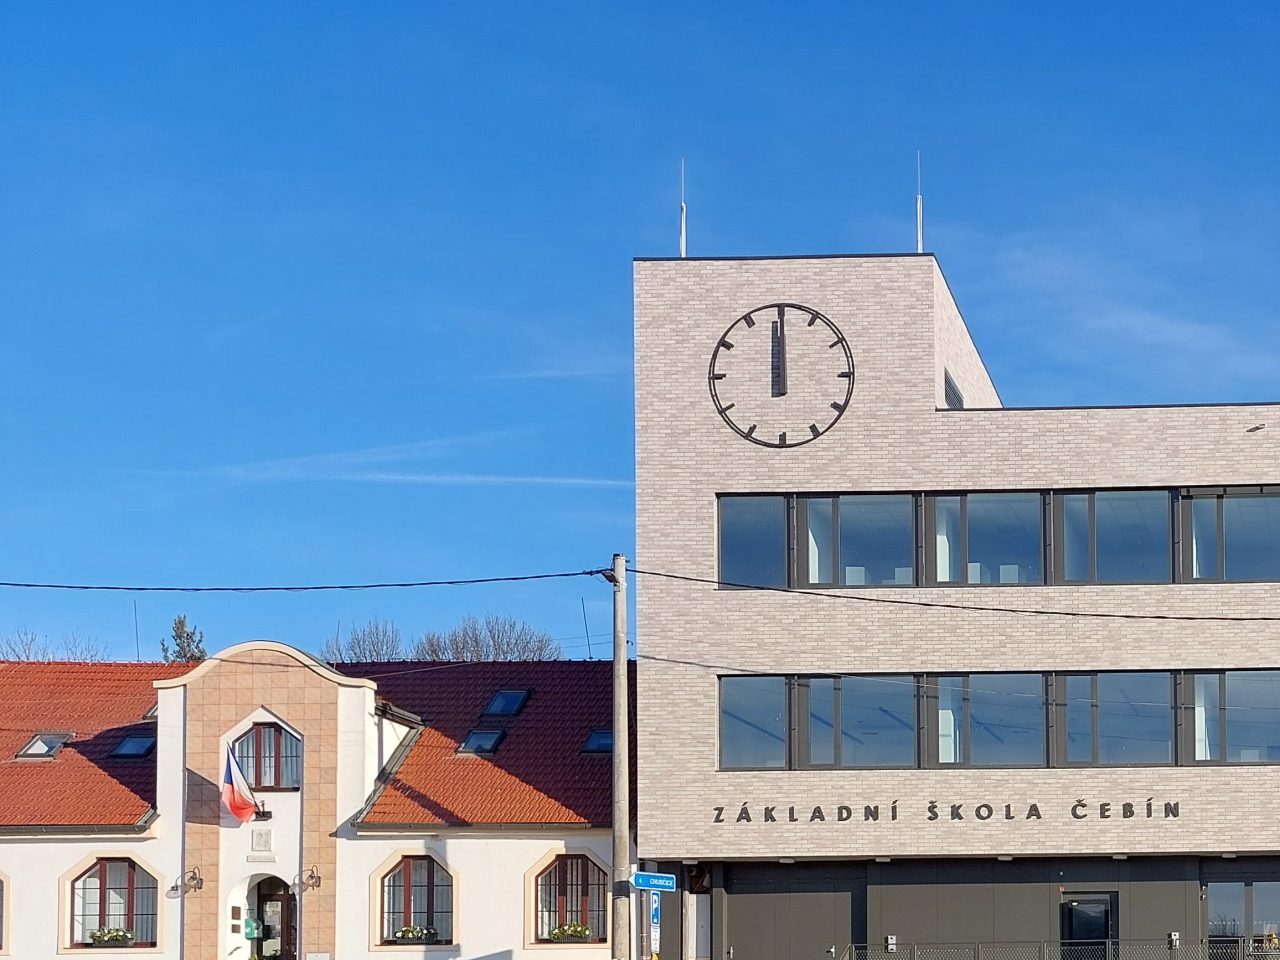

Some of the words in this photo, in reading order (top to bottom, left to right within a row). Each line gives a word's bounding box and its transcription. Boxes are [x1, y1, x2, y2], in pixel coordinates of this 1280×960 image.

[713, 800, 898, 823] ZÁKLADNÍ
[927, 800, 1042, 821] ŠKOLA
[1071, 797, 1180, 820] ČEBÍN
